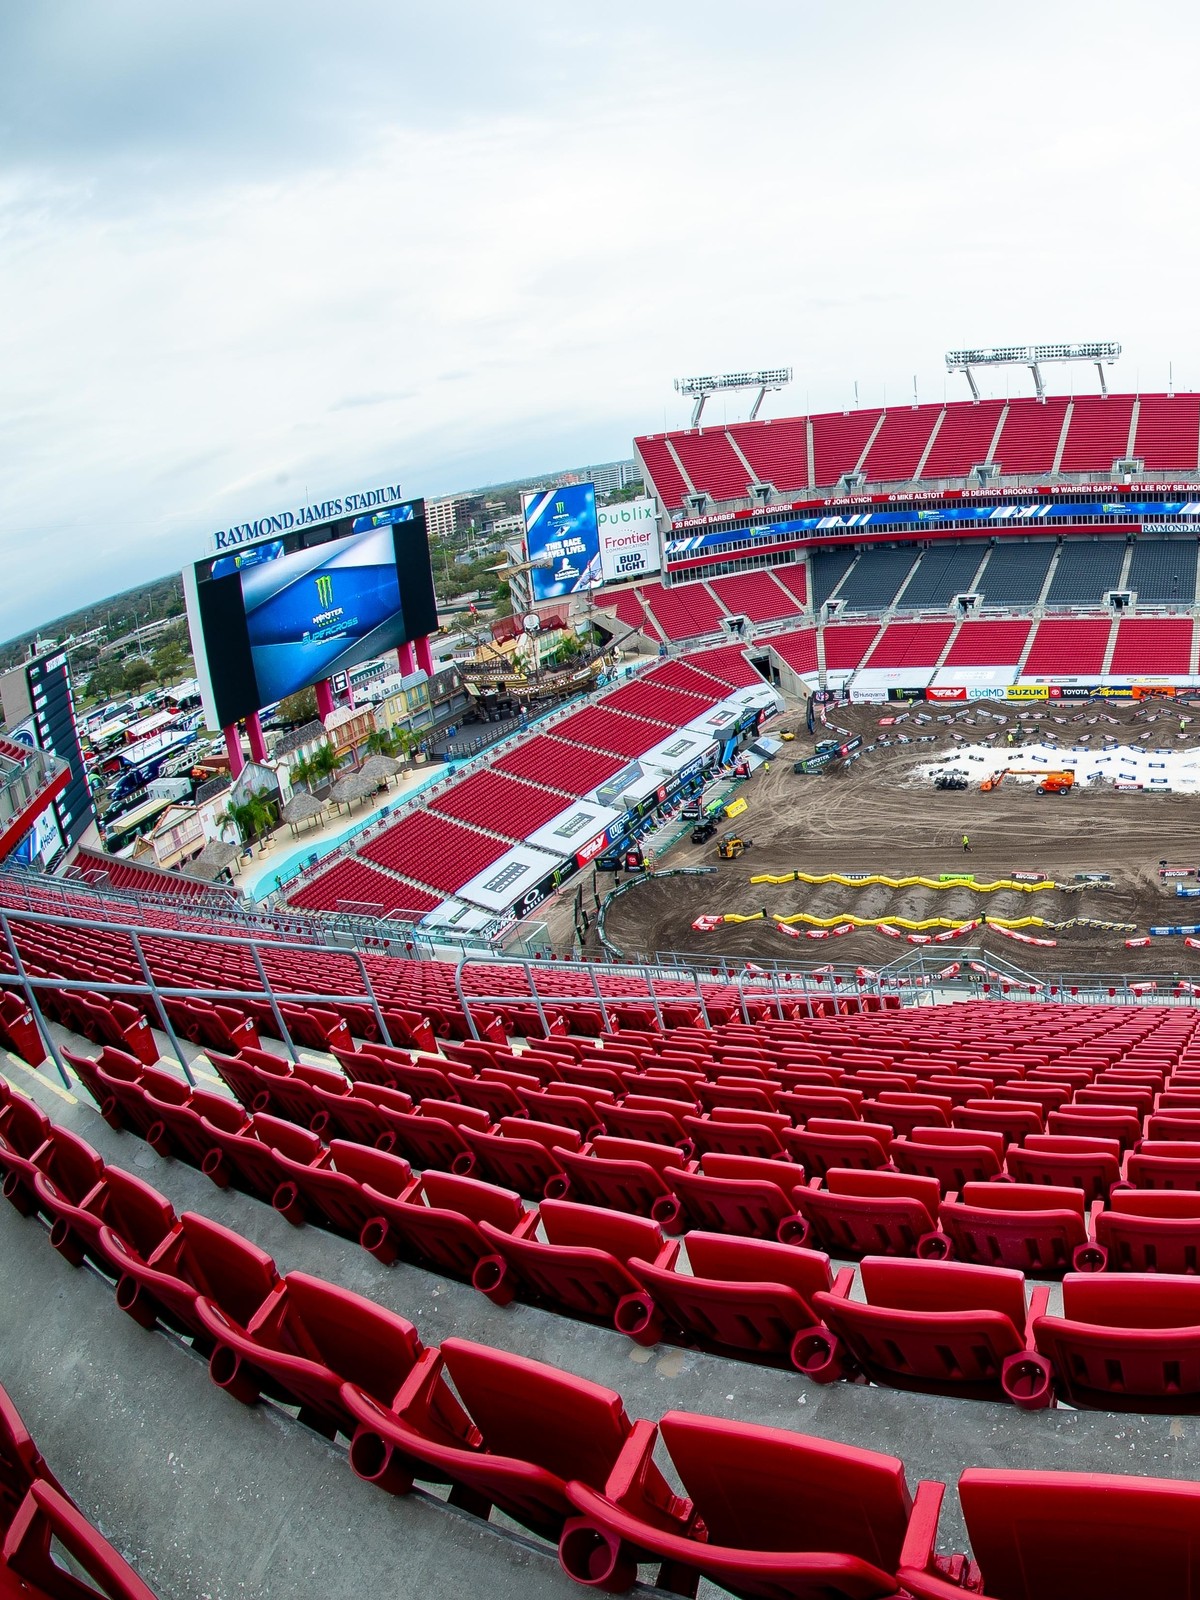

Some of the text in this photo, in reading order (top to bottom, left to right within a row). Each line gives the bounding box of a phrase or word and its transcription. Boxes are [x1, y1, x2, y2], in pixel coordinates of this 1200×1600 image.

[766, 504, 792, 514] GRUDEN
[214, 484, 402, 550] RAYMOND JAMES STADIUM
[708, 513, 736, 523] BARBER
[545, 537, 582, 551] THIS RACE
[605, 532, 651, 549] Frontier
[566, 544, 586, 555] LIVES
[620, 553, 641, 564] BUD
[616, 560, 646, 574] LIGHT
[969, 688, 1004, 698] cbdMD
[666, 778, 681, 792] TOYOTA
[522, 893, 545, 914] OAKLEY
